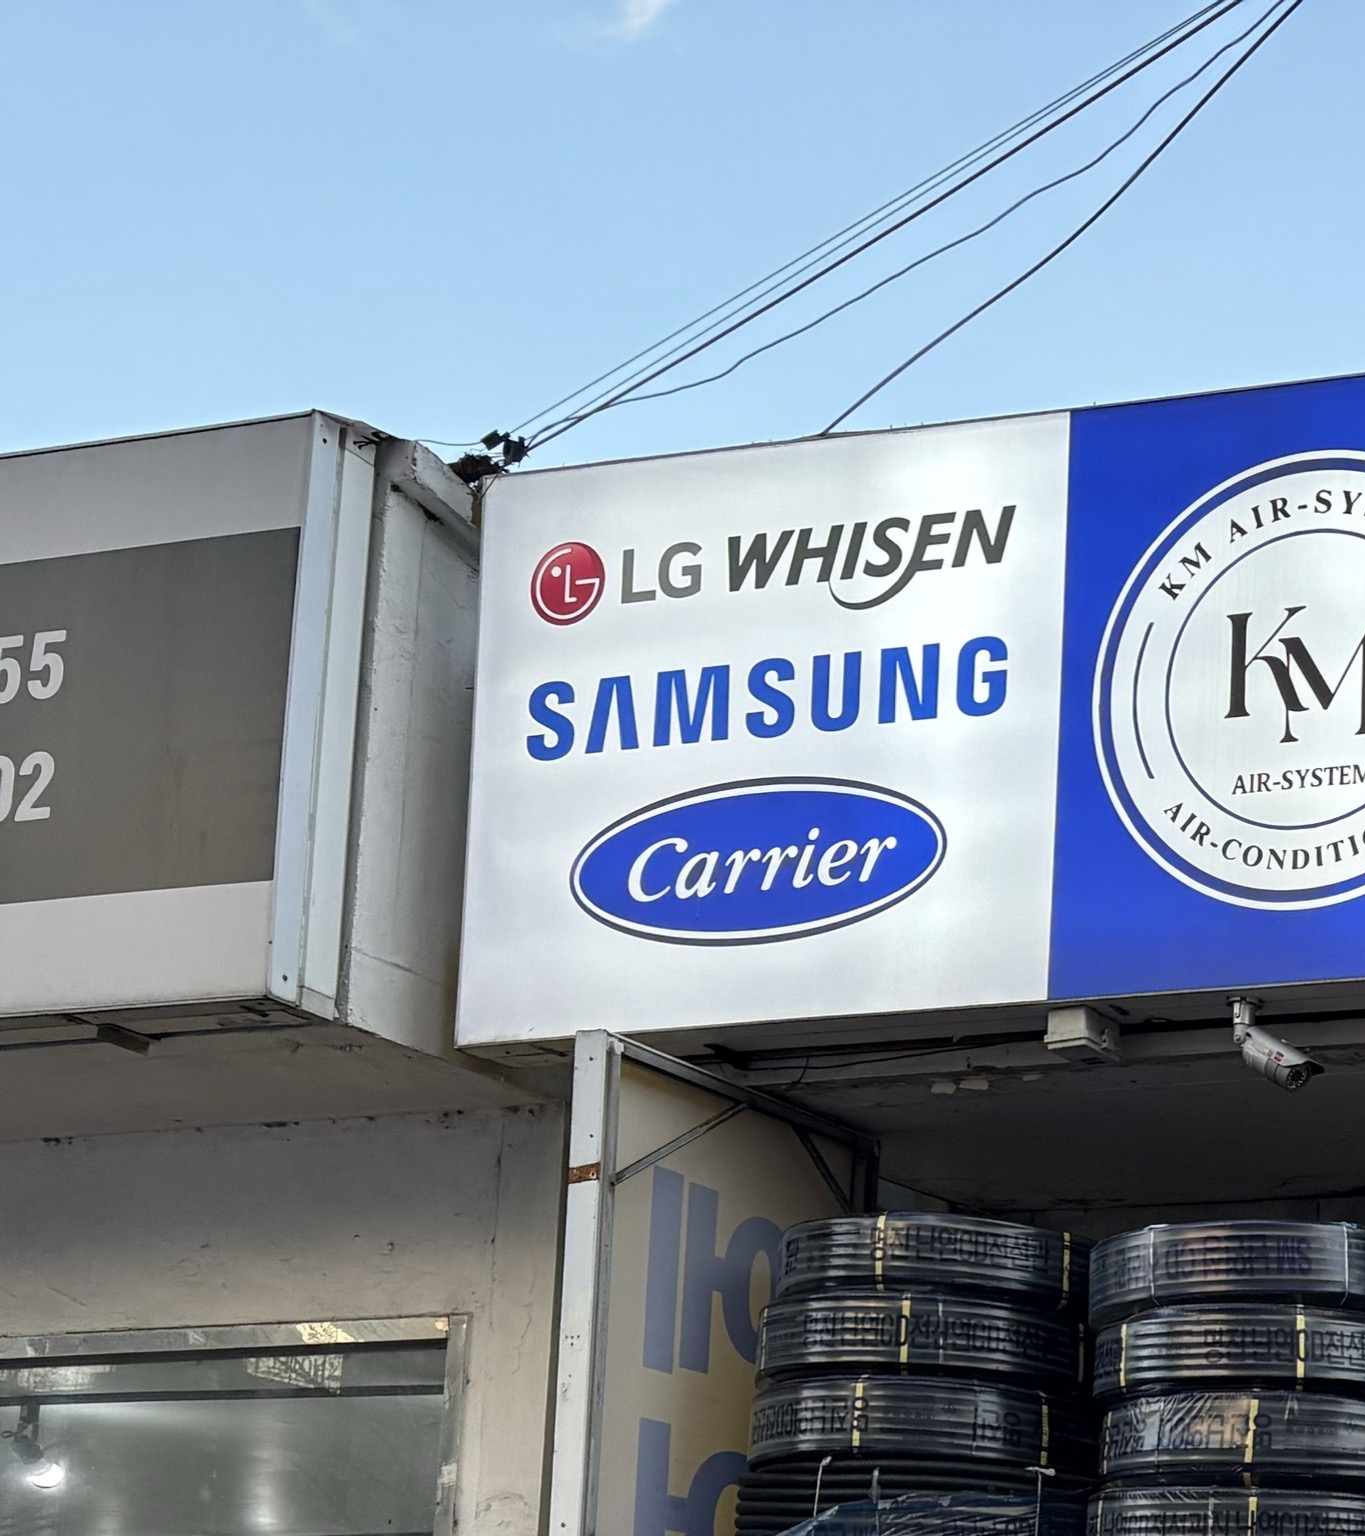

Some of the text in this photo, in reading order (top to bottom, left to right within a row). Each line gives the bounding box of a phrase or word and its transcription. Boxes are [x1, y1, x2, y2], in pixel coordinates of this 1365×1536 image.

[621, 504, 1016, 611] LG WHISEN
[1157, 541, 1213, 600] KM
[525, 635, 1008, 762] SAMSUNG
[627, 826, 898, 902] Carrier
